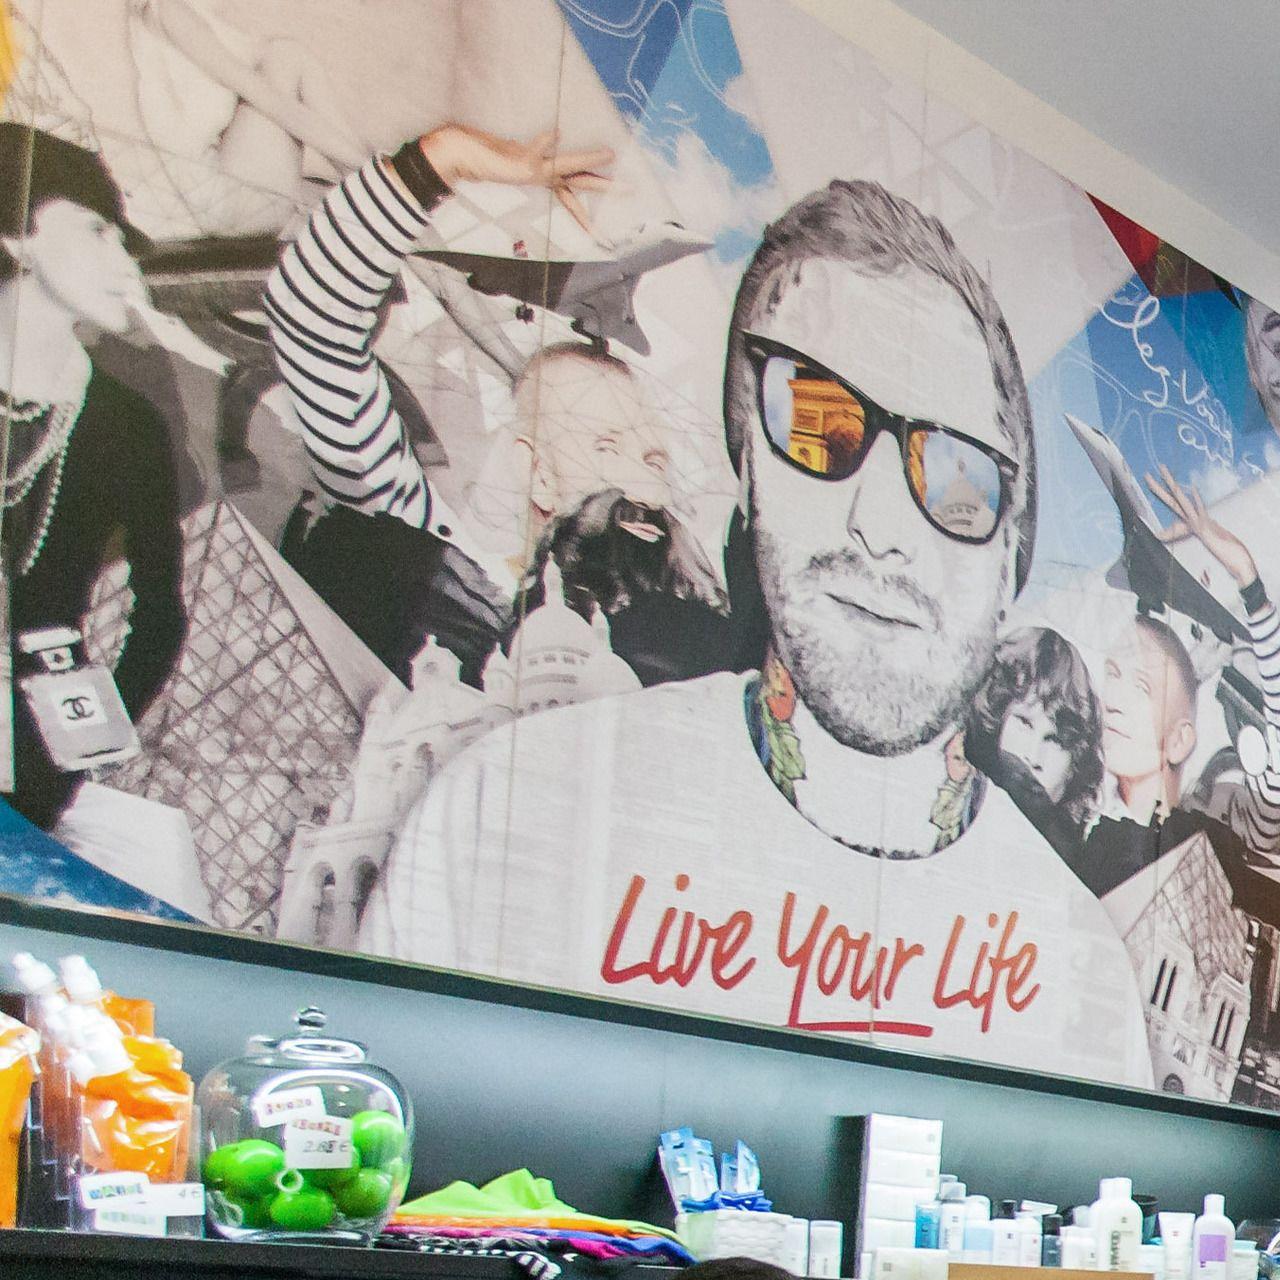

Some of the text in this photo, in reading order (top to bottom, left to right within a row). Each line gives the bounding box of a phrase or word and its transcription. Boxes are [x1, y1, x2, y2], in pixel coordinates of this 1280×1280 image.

[601, 874, 1041, 1033] Live Your Life
